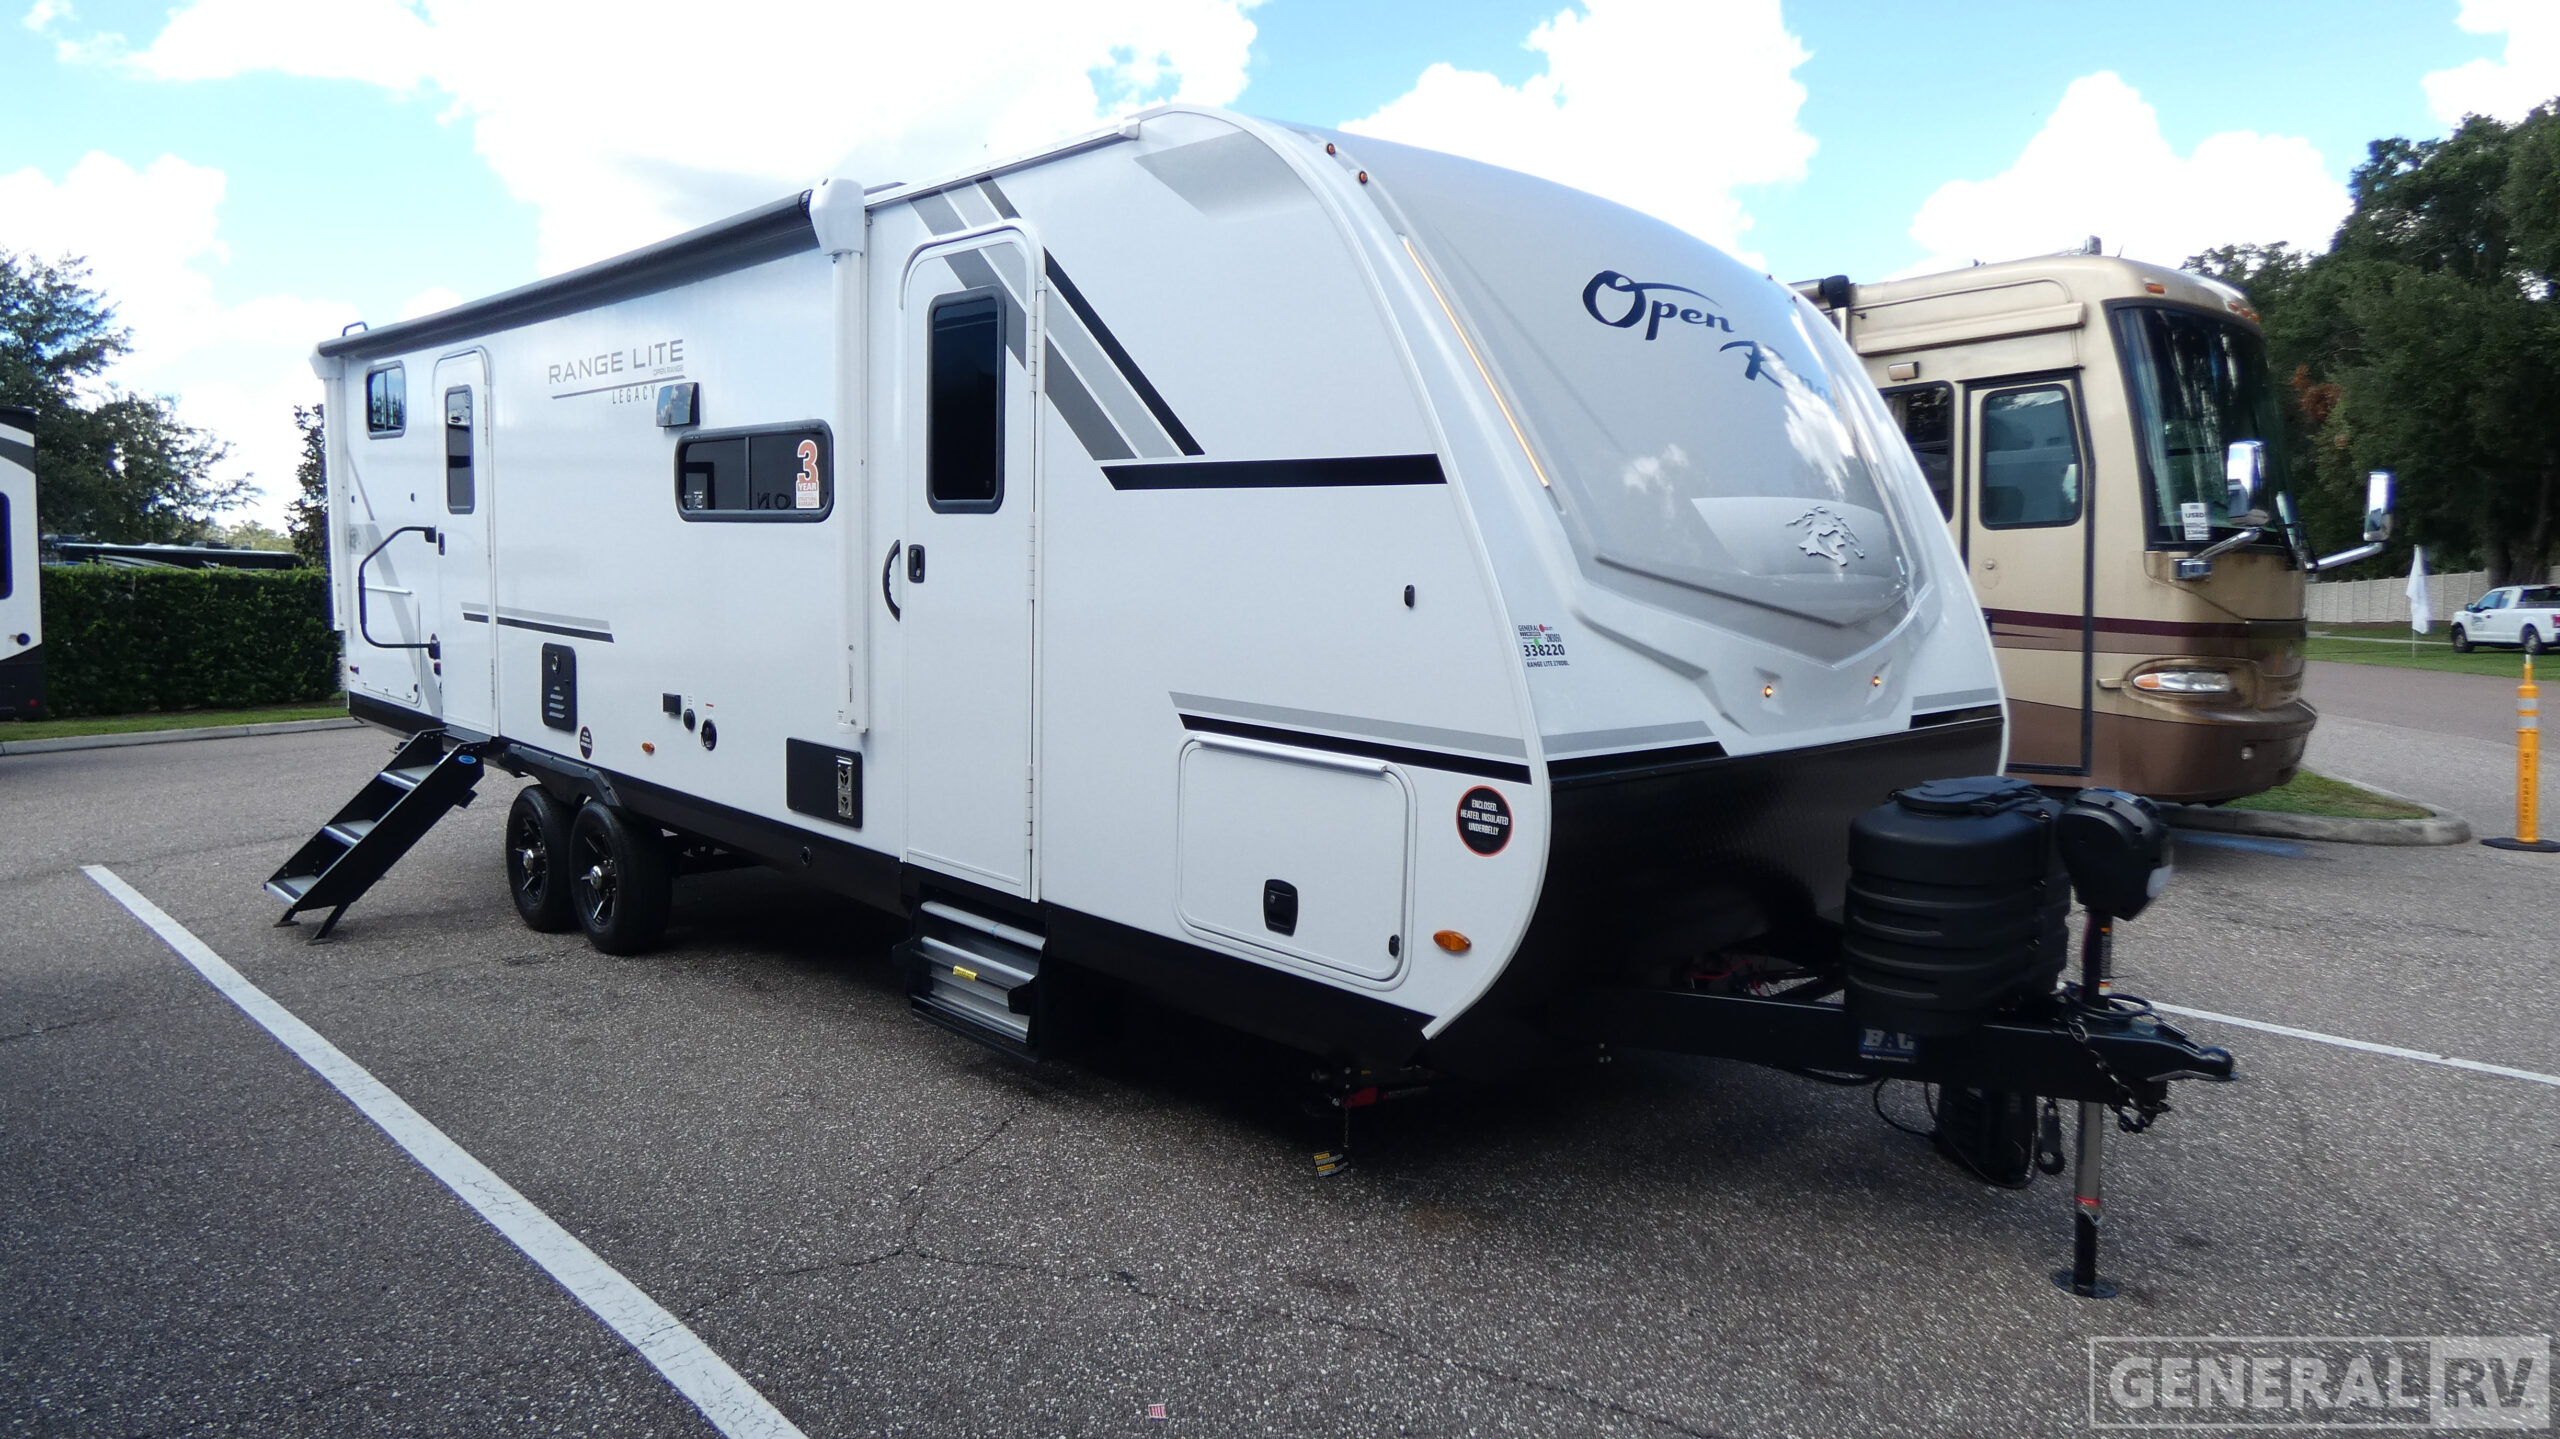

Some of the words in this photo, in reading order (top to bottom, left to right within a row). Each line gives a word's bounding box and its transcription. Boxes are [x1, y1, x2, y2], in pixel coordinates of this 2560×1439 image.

[1582, 270, 1735, 340] Open
[549, 351, 623, 384] RANGE
[633, 339, 683, 369] LITE
[612, 384, 656, 404] LEGACY
[797, 439, 819, 483] 3
[798, 482, 817, 491] YEAR
[1523, 644, 1565, 657] 338220
[1472, 799, 1498, 812] ENCLOSED,
[1460, 809, 1480, 820] HEATED,
[1481, 813, 1509, 825] INSULATED
[1468, 822, 1499, 835] UNDERBELLY
